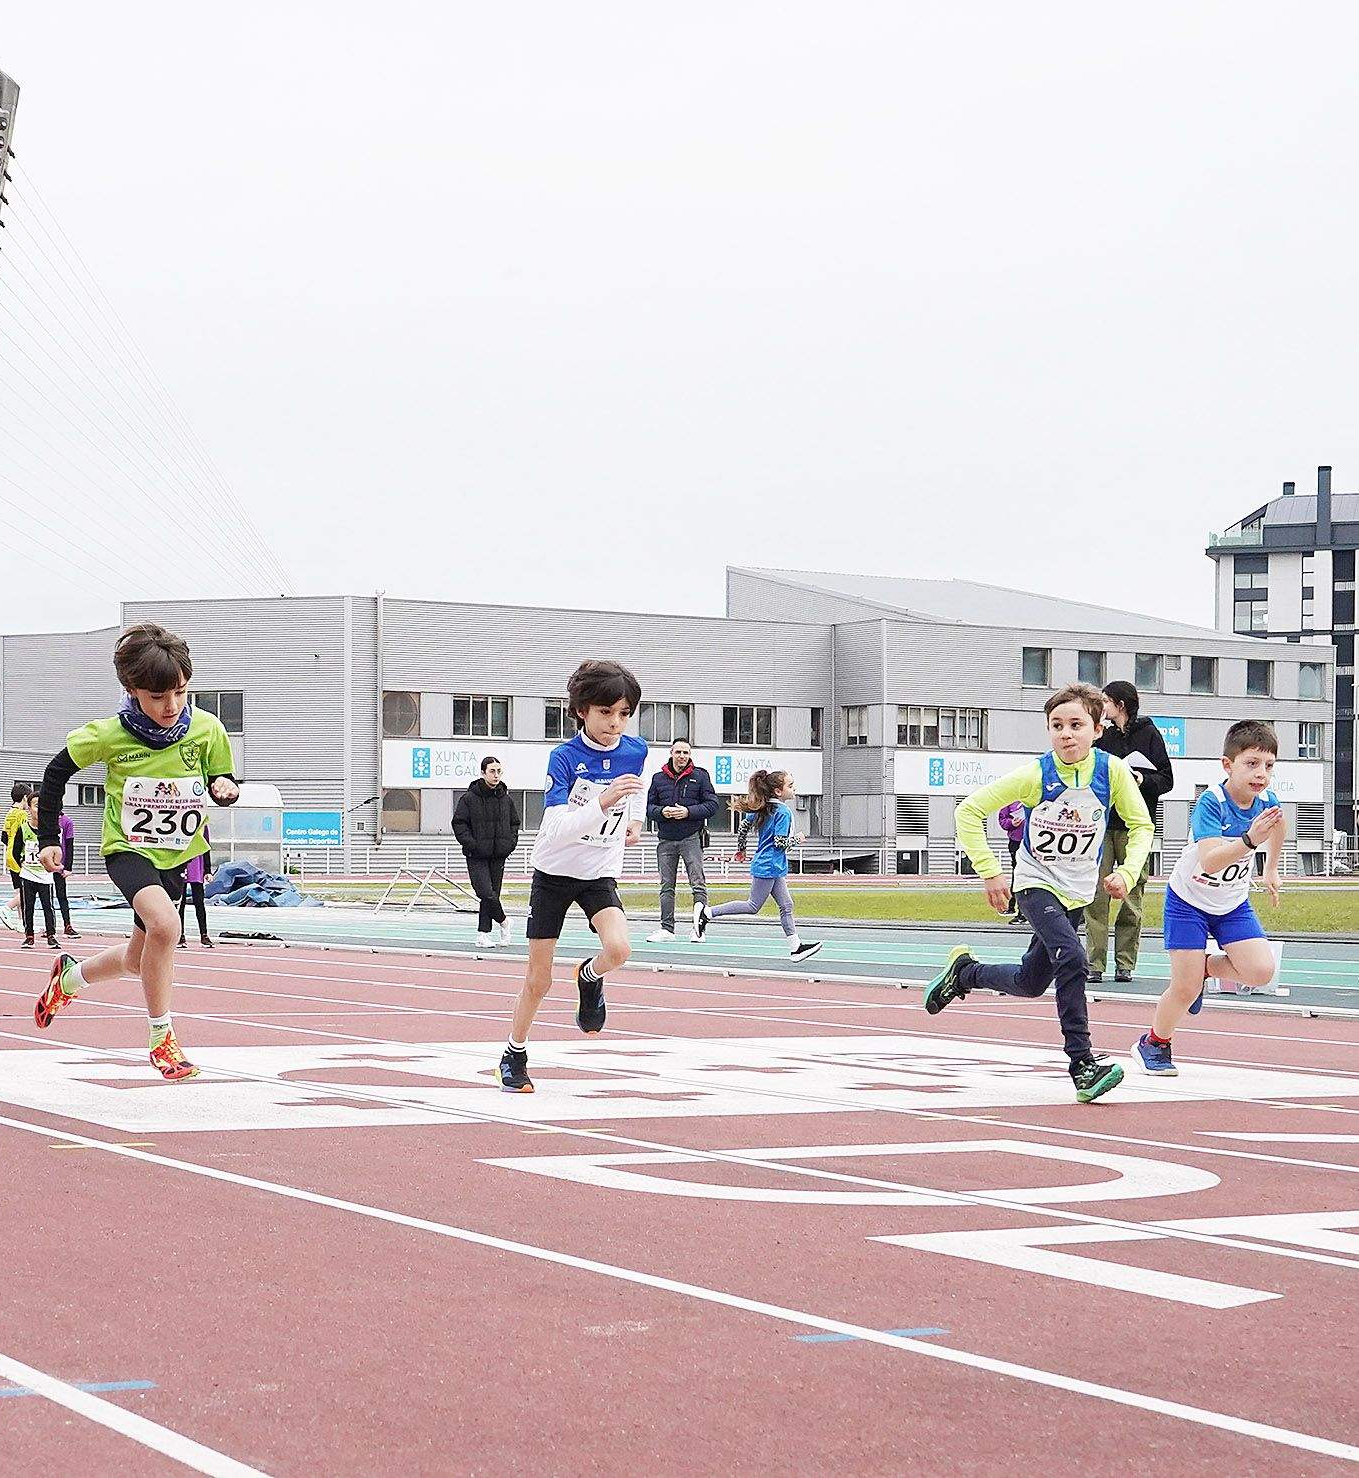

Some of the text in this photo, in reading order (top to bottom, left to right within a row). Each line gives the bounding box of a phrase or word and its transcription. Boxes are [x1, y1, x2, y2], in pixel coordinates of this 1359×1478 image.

[435, 750, 477, 762] XUNTA
[736, 758, 772, 769] XUNTA
[948, 760, 982, 771] XUNTA
[435, 765, 450, 776] DE
[736, 772, 748, 782] DE
[948, 775, 961, 785] DE
[131, 808, 202, 836] 230
[1031, 821, 1046, 830] GRAN
[1046, 825, 1068, 833] PREMIO
[1043, 819, 1066, 828] TORNEO
[308, 828, 329, 836] Galego
[1035, 830, 1096, 855] 207
